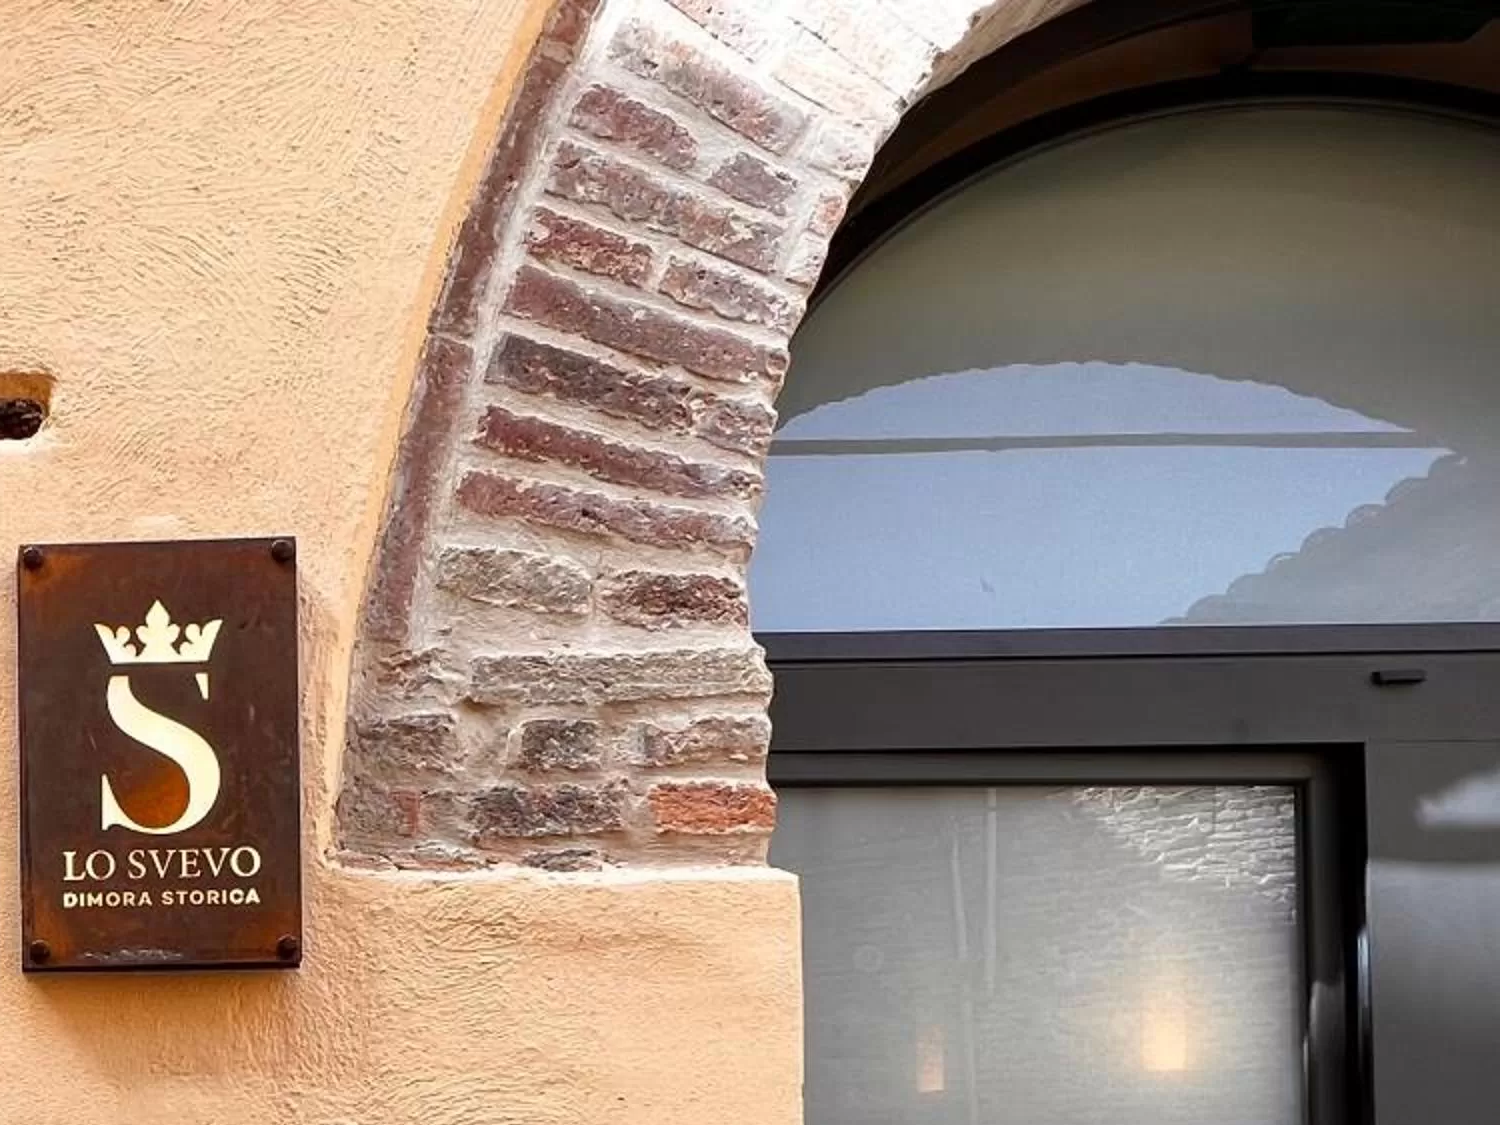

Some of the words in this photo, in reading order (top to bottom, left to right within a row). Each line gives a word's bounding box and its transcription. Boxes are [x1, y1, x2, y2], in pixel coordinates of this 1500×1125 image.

[101, 672, 221, 835] S
[62, 850, 116, 881] LO
[127, 846, 261, 880] SVEVO
[63, 891, 153, 908] DIMORA
[161, 887, 261, 905] STORICA
